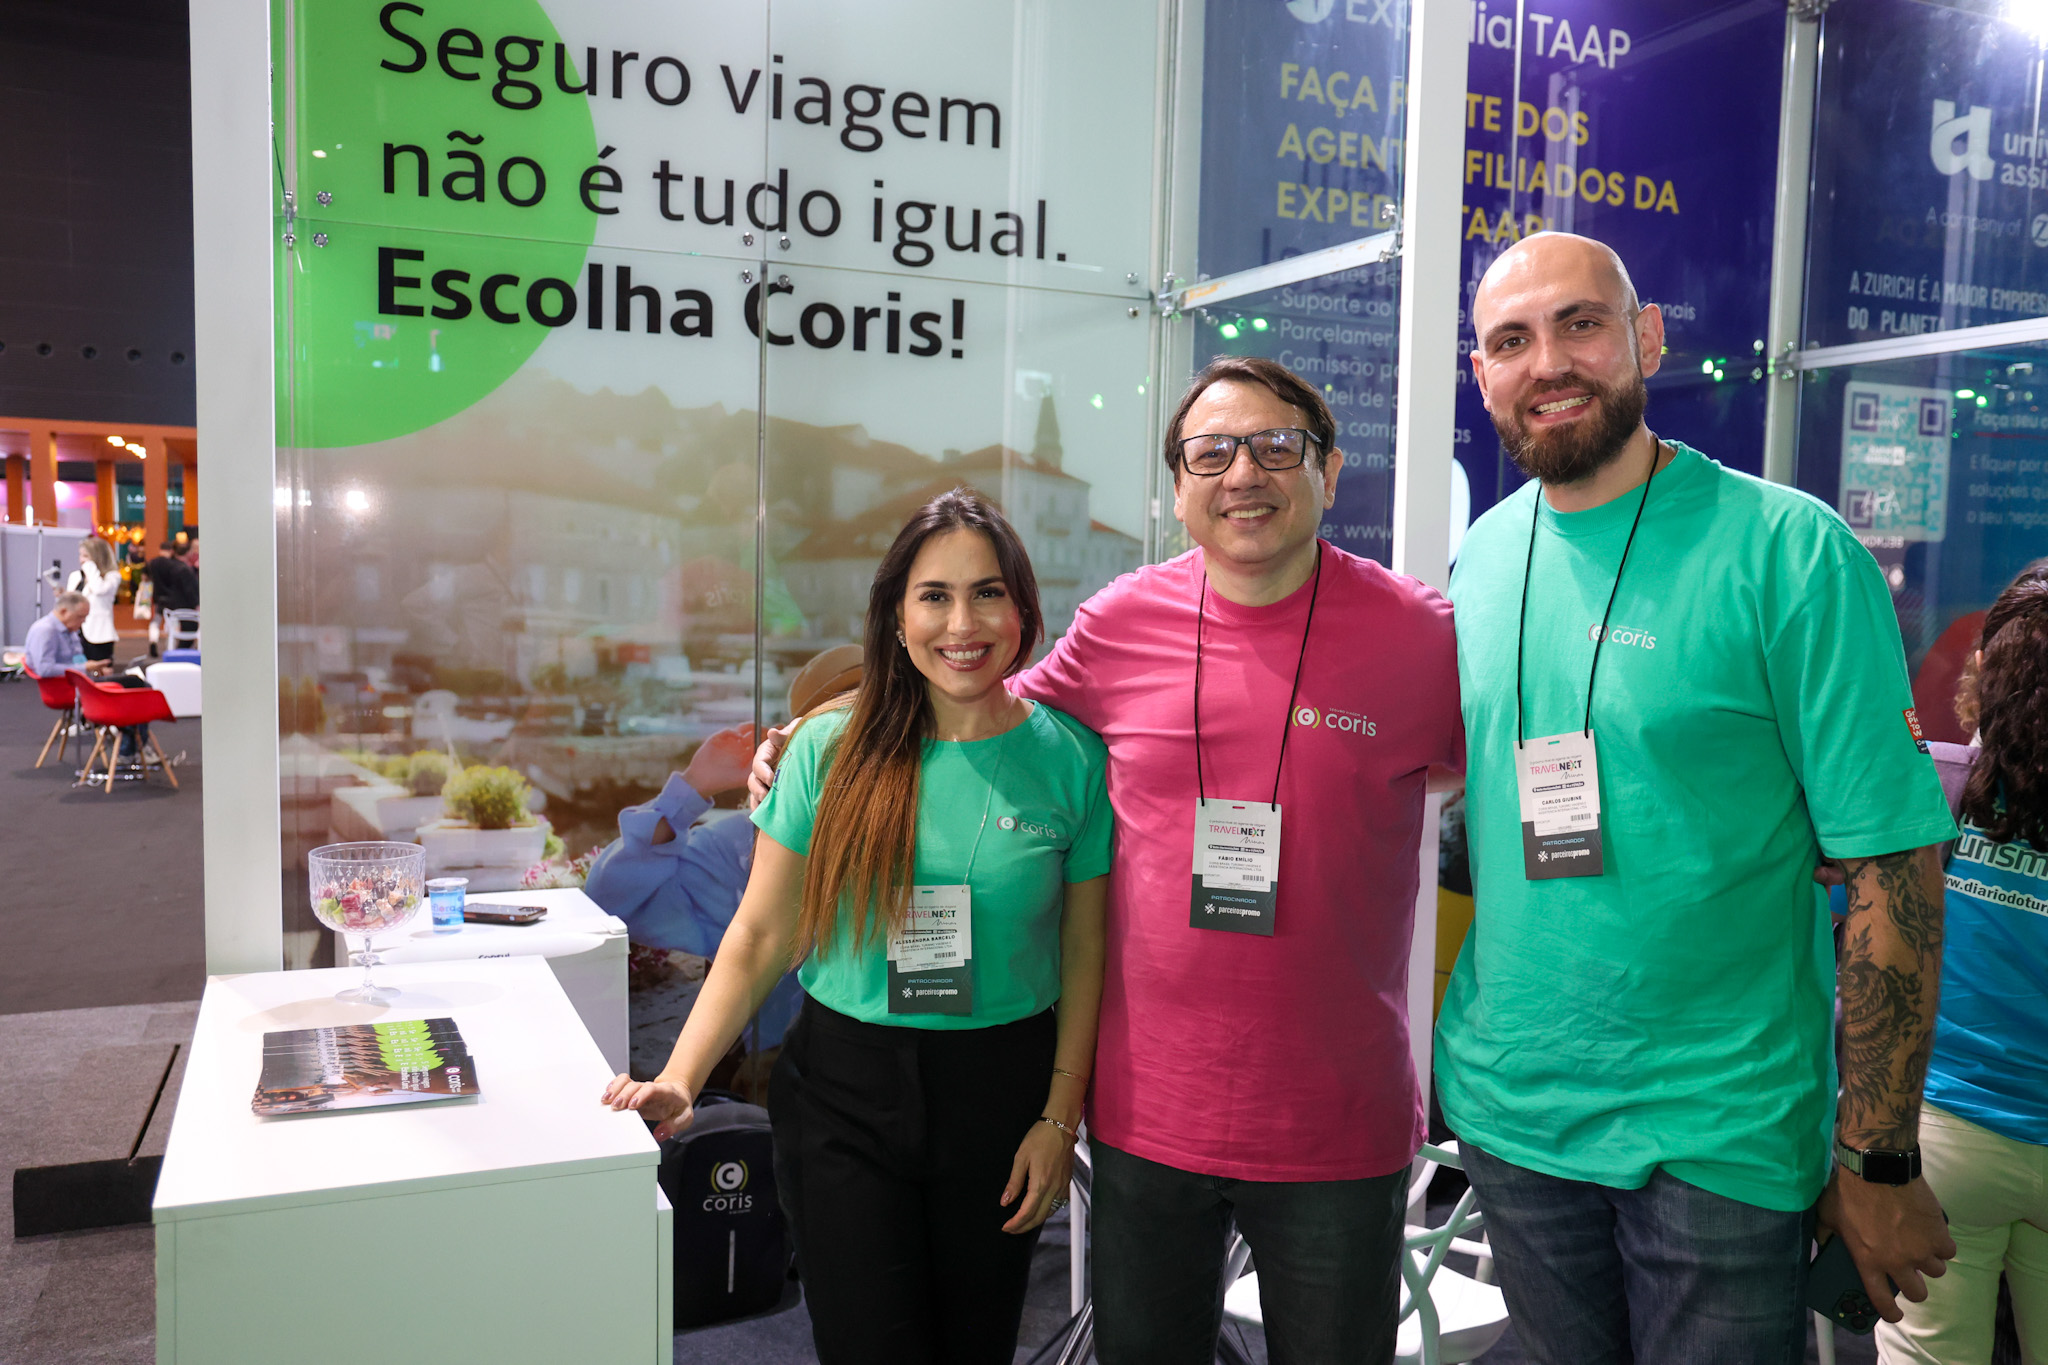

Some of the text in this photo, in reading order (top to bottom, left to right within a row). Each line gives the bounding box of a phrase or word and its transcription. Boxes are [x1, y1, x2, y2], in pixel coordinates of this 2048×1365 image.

[1529, 13, 1631, 69] TAAP
[379, 1, 1001, 152] Seguro viagem
[1280, 62, 1379, 118] FAÇA
[1517, 101, 1589, 146] DOS
[1465, 149, 1626, 207] FILIADOS
[1634, 175, 1680, 215] DA
[382, 130, 1067, 268] não é tudo igual.
[377, 246, 966, 360] Escolha Coris!
[1281, 287, 1361, 315] Suporte
[1849, 271, 1860, 293] A
[1863, 272, 1915, 299] ZURICH
[1919, 274, 1928, 302] É
[1931, 281, 1940, 302] A
[1944, 282, 1988, 309] MAIOR
[1848, 306, 1869, 331] DO
[1880, 310, 1946, 334] PLANETA
[1279, 350, 1375, 377] Comissão
[1611, 629, 1657, 650] coris
[1325, 713, 1377, 737] coris
[1530, 760, 1582, 775] TRAVELNEXT
[1020, 822, 1057, 839] coris
[1209, 824, 1266, 837] TRAVELNEXT
[1542, 837, 1585, 846] PATROCINADOR
[1954, 834, 2048, 879] urism
[903, 908, 957, 920] RAVELNEXT
[703, 1192, 753, 1212] coris
